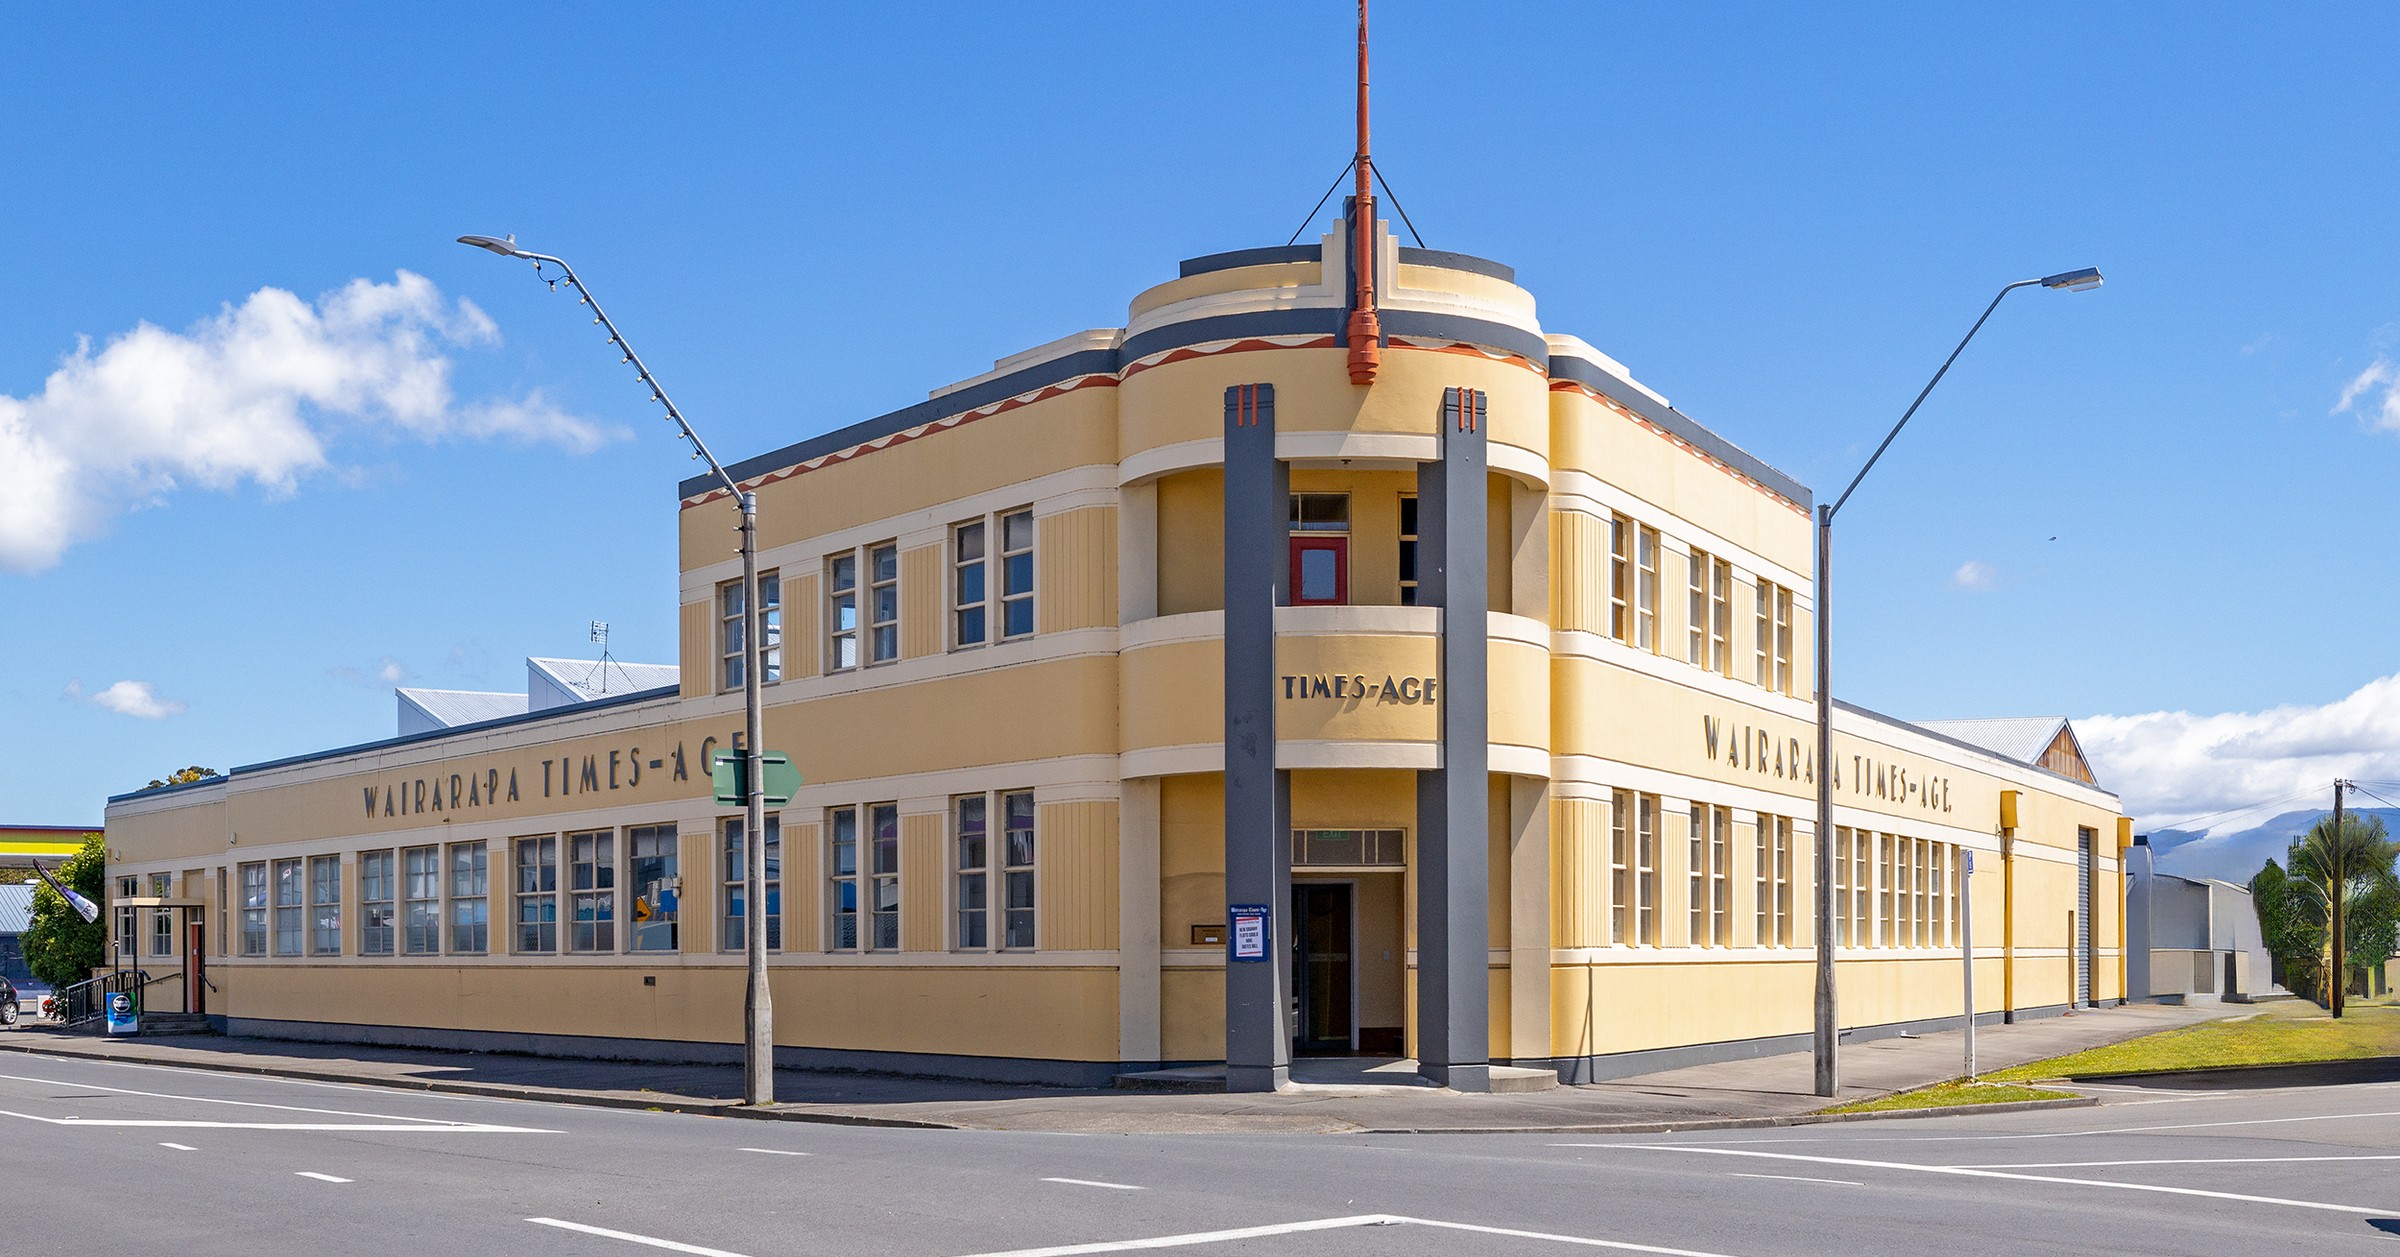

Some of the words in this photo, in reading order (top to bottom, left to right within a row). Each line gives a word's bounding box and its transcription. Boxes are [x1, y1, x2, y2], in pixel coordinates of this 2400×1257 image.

[1282, 674, 1437, 700] TIMES-AGE
[1704, 714, 1841, 790] WAIRARAA
[363, 766, 520, 819] WAIRARAPA
